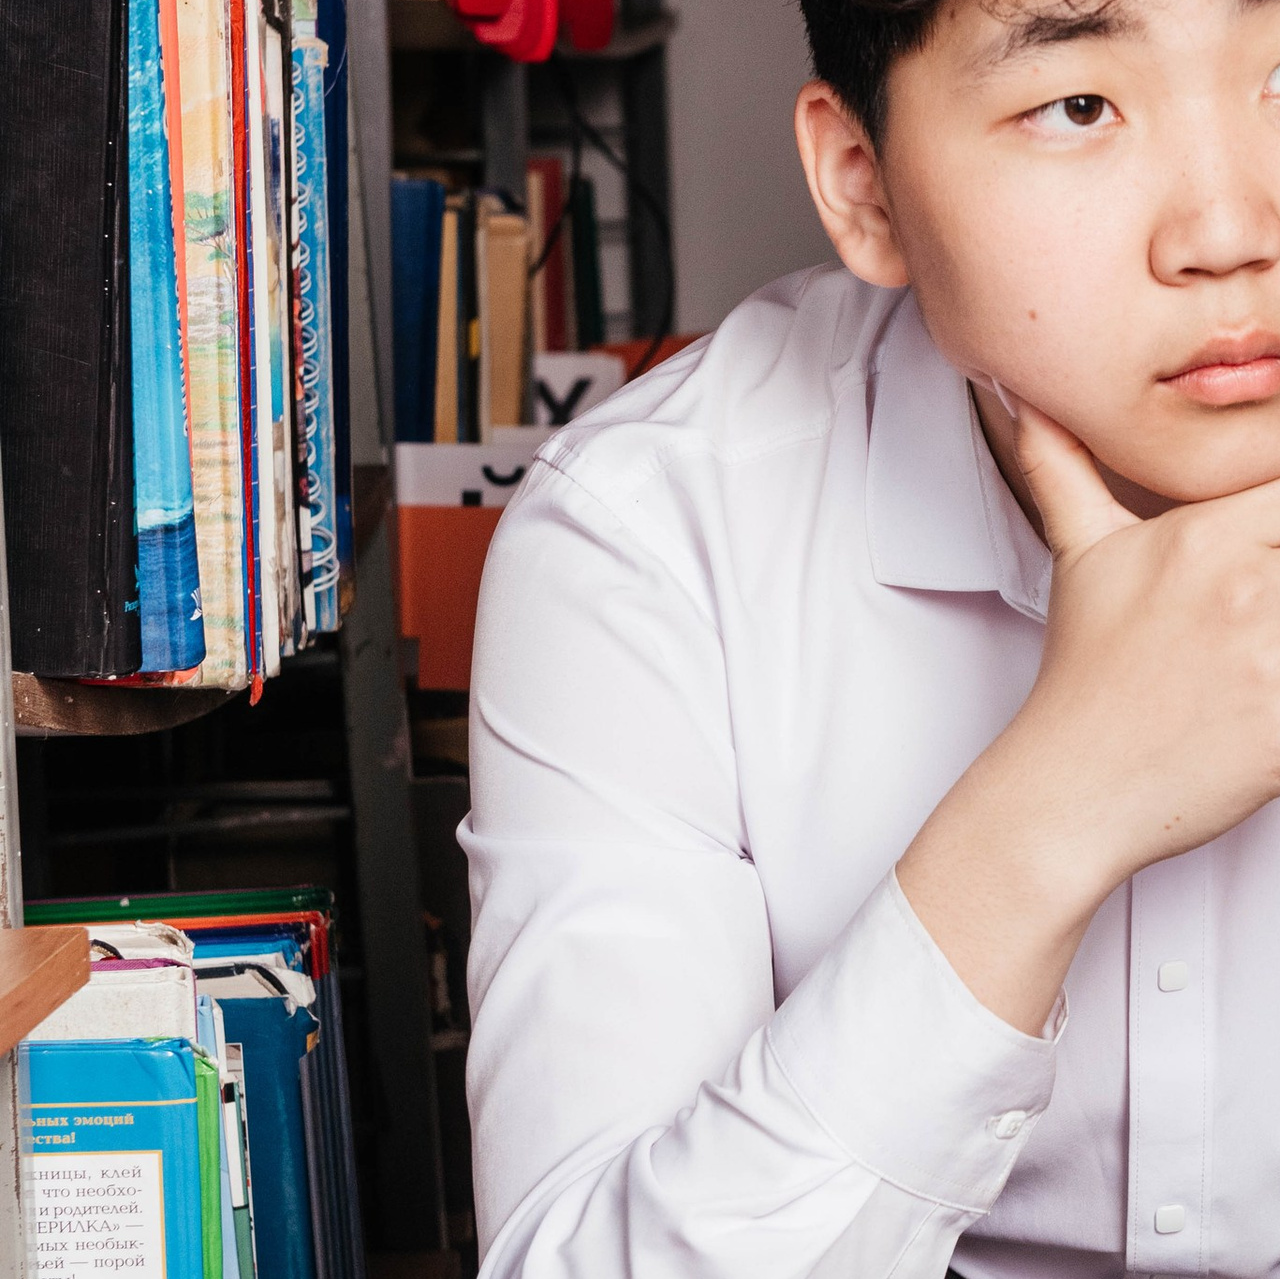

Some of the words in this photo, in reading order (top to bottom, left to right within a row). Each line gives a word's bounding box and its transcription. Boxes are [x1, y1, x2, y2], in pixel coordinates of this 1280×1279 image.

[73, 1113, 134, 1128] эмоций
[101, 1165, 142, 1179] клей
[42, 1186, 71, 1198] что
[76, 1184, 143, 1198] необхо-
[54, 1202, 143, 1219] родителей.
[75, 1238, 144, 1252] необык-
[94, 1255, 146, 1271] порой
